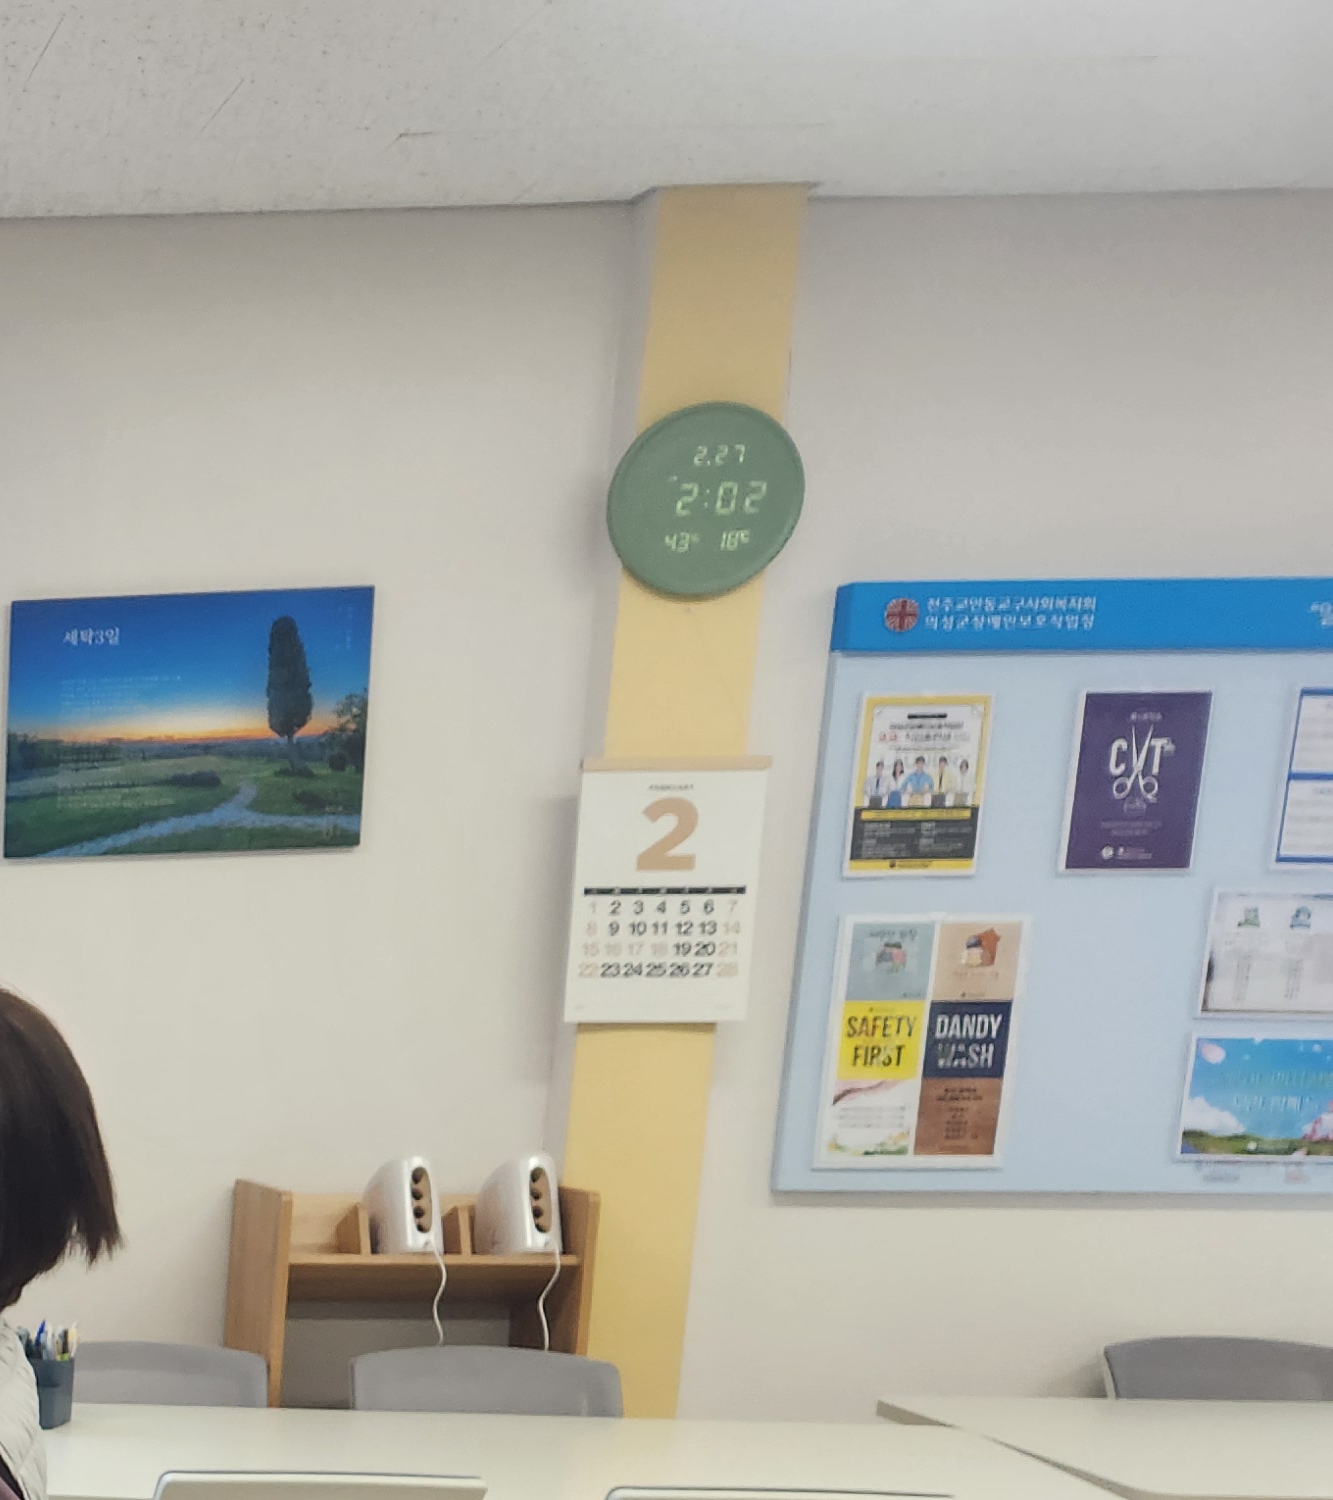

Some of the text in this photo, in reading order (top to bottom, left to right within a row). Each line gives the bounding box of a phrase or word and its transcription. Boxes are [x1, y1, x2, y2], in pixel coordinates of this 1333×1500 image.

[694, 444, 746, 466] 2.27
[675, 480, 767, 516] 2:02
[635, 796, 698, 872] 2
[610, 900, 621, 916] 2
[633, 900, 644, 916] 3
[656, 900, 667, 915] 4
[680, 900, 690, 915] 5
[703, 900, 715, 915] 6
[609, 921, 620, 936] 9
[629, 921, 647, 936] 10
[652, 920, 668, 935] 11
[676, 920, 694, 936] 12
[699, 920, 717, 936] 13
[673, 941, 692, 957] 19
[694, 941, 716, 957] 20
[600, 963, 621, 978] 23
[622, 963, 643, 978] 24
[645, 963, 667, 978] 25
[669, 963, 691, 978] 26
[692, 963, 713, 977] 27
[846, 1016, 917, 1039] SAFETY
[935, 1013, 1003, 1039] DANDY
[852, 1045, 906, 1068] FIRST
[937, 1043, 995, 1068] WASH
